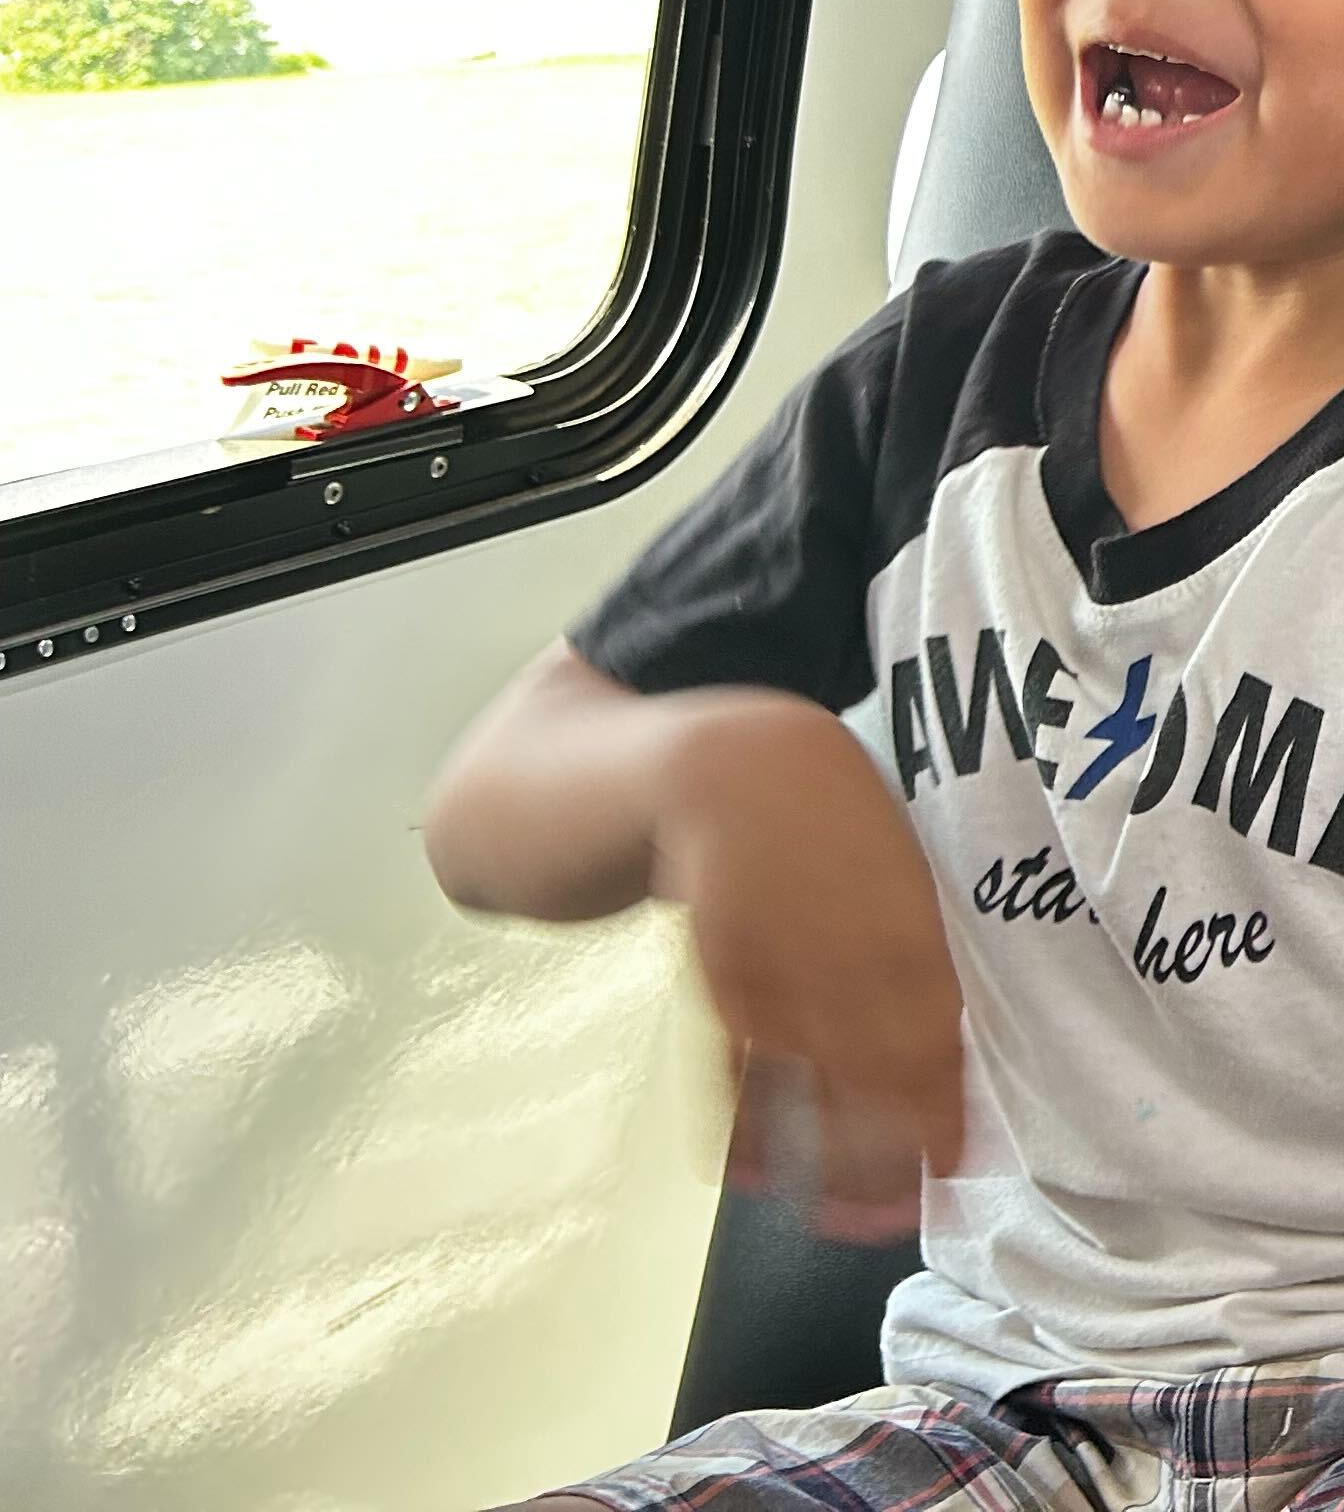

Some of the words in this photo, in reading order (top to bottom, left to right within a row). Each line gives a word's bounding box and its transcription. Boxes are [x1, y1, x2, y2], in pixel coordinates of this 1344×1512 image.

[265, 382, 302, 396] Pull
[973, 845, 1100, 924] sta
[1133, 886, 1276, 984] here
